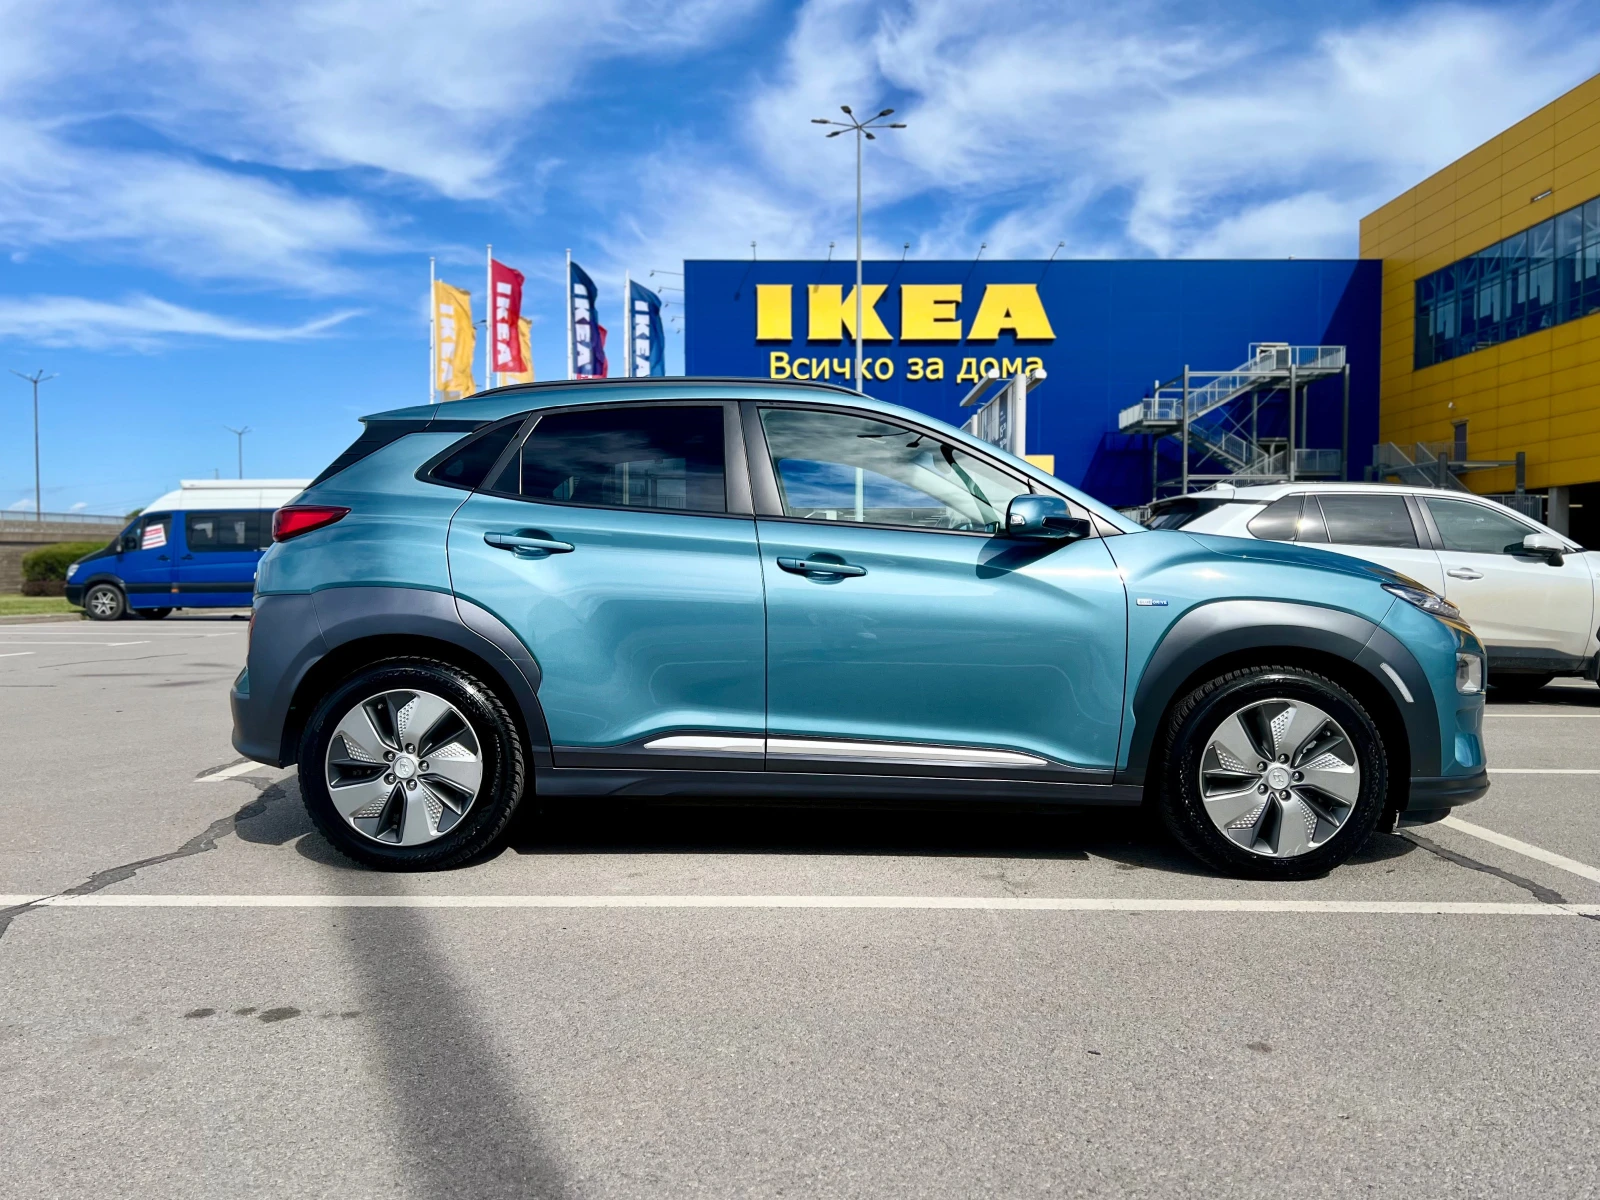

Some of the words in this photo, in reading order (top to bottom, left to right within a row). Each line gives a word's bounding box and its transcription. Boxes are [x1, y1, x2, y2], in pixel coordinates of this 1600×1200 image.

[440, 304, 456, 382] IKEA
[496, 282, 513, 365] IKEA
[573, 283, 592, 367] IKEA
[634, 300, 651, 377] IKEA
[756, 284, 1056, 341] IKEA
[769, 352, 895, 381] Всичко
[906, 357, 945, 381] за
[956, 356, 1044, 384] дома
